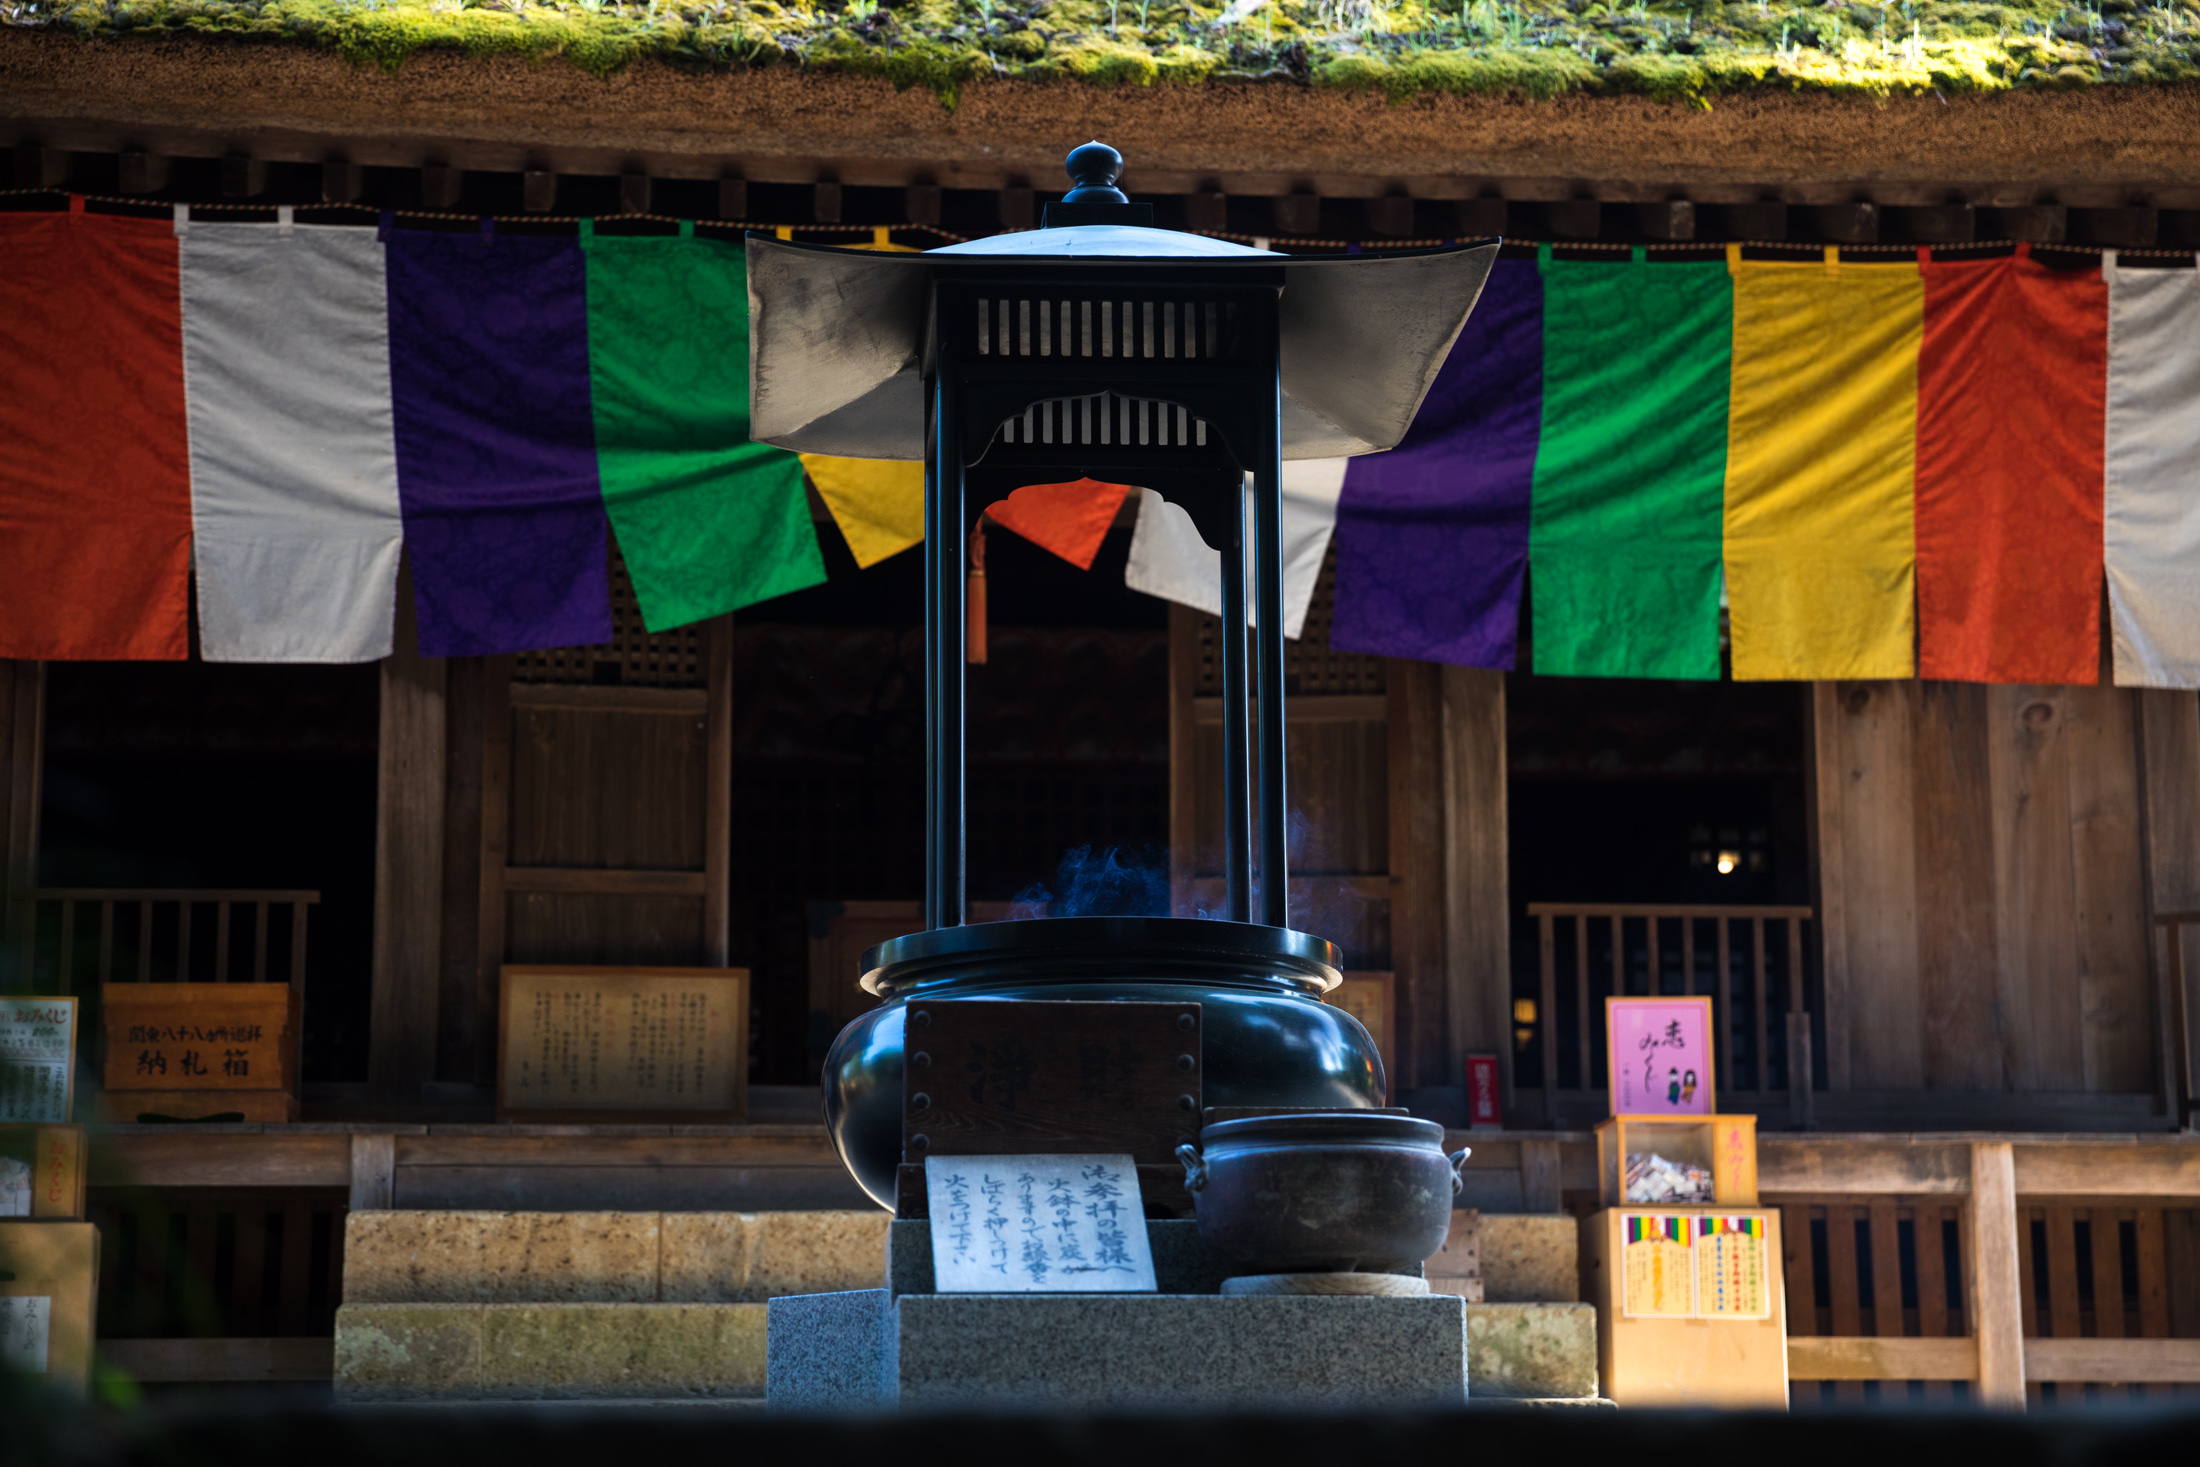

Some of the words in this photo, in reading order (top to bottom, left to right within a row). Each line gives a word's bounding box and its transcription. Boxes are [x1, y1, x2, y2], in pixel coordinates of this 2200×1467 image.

[14, 1008, 67, 1024] おみくじ
[49, 1141, 65, 1203] おみくじ
